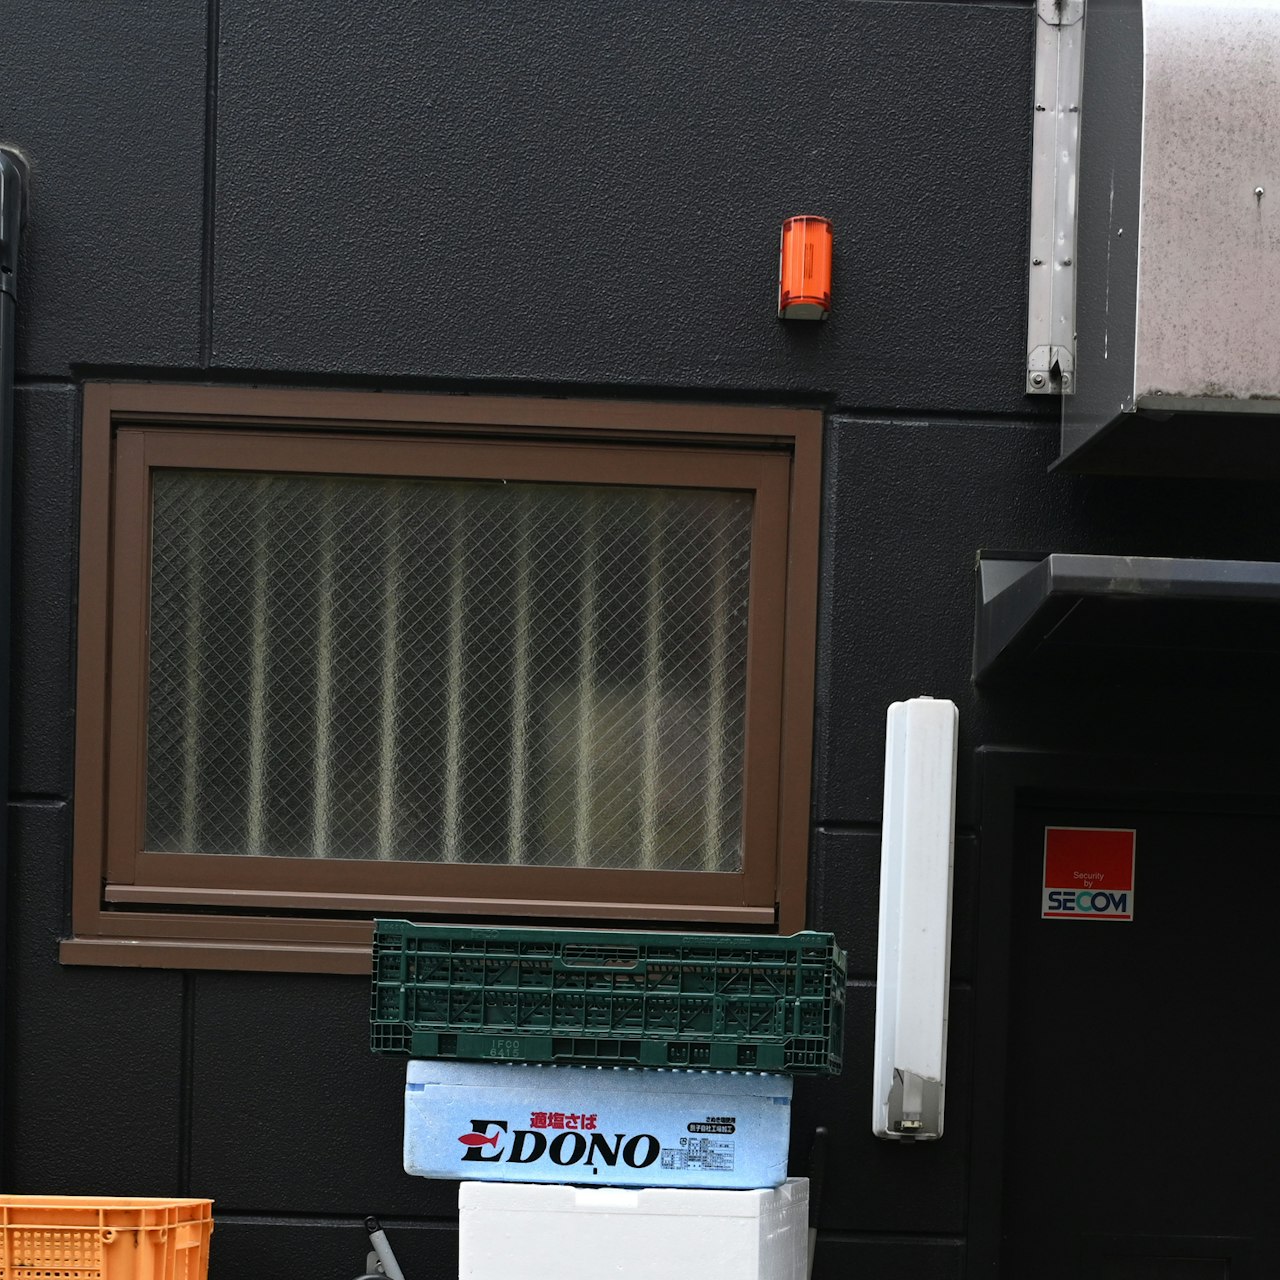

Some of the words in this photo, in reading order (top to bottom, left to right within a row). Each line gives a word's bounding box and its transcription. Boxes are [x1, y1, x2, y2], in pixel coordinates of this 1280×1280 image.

[1073, 871, 1105, 881] Security
[1083, 880, 1094, 888] by
[1048, 891, 1127, 912] SECOM
[491, 1039, 520, 1049] IFCO
[490, 1048, 520, 1058] 6415
[529, 1111, 598, 1131] 適塩さば
[458, 1119, 661, 1169] EDONO
